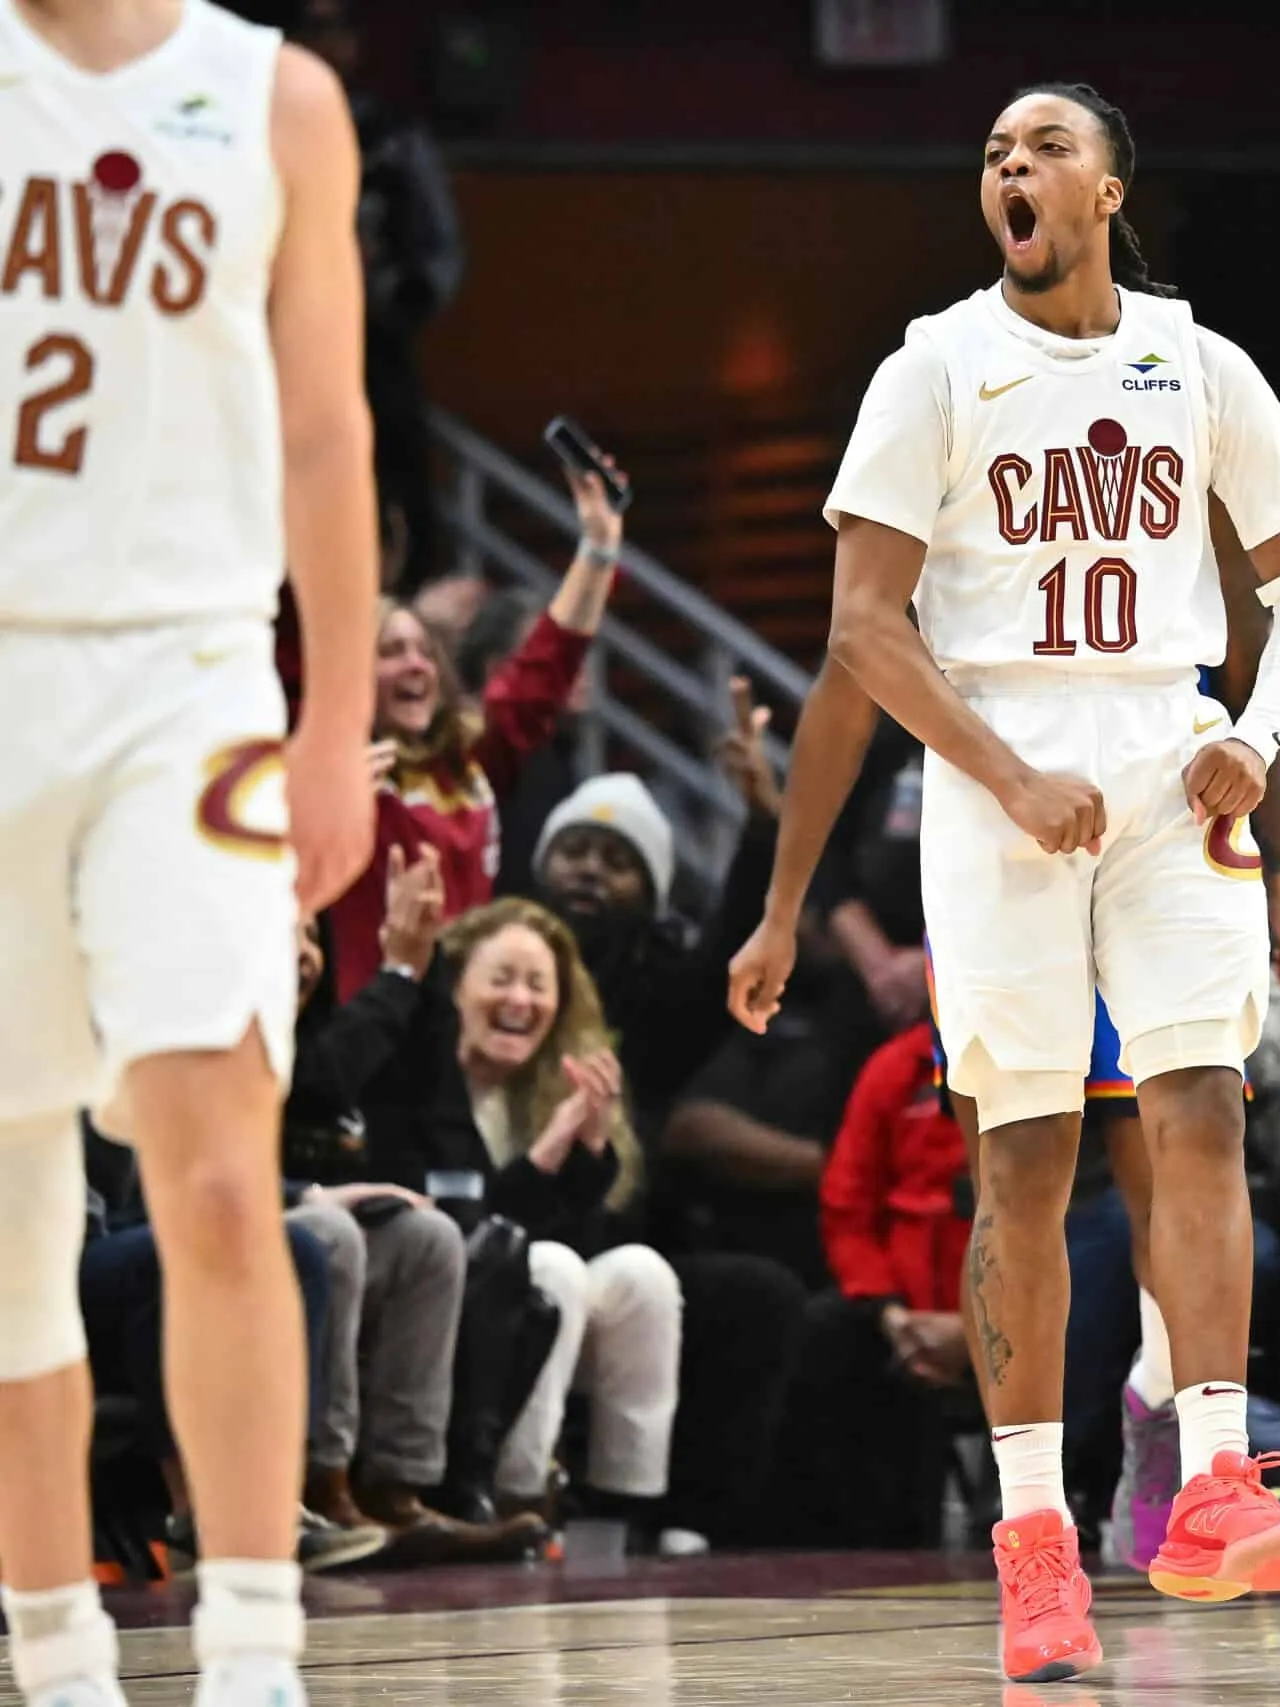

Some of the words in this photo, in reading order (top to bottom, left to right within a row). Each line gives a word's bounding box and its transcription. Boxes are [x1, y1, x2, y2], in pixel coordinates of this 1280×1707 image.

[0, 174, 217, 318] AVS
[12, 332, 96, 476] 2
[1121, 379, 1182, 392] CLIFFS
[987, 445, 1184, 546] CAVS
[1032, 556, 1138, 656] 10
